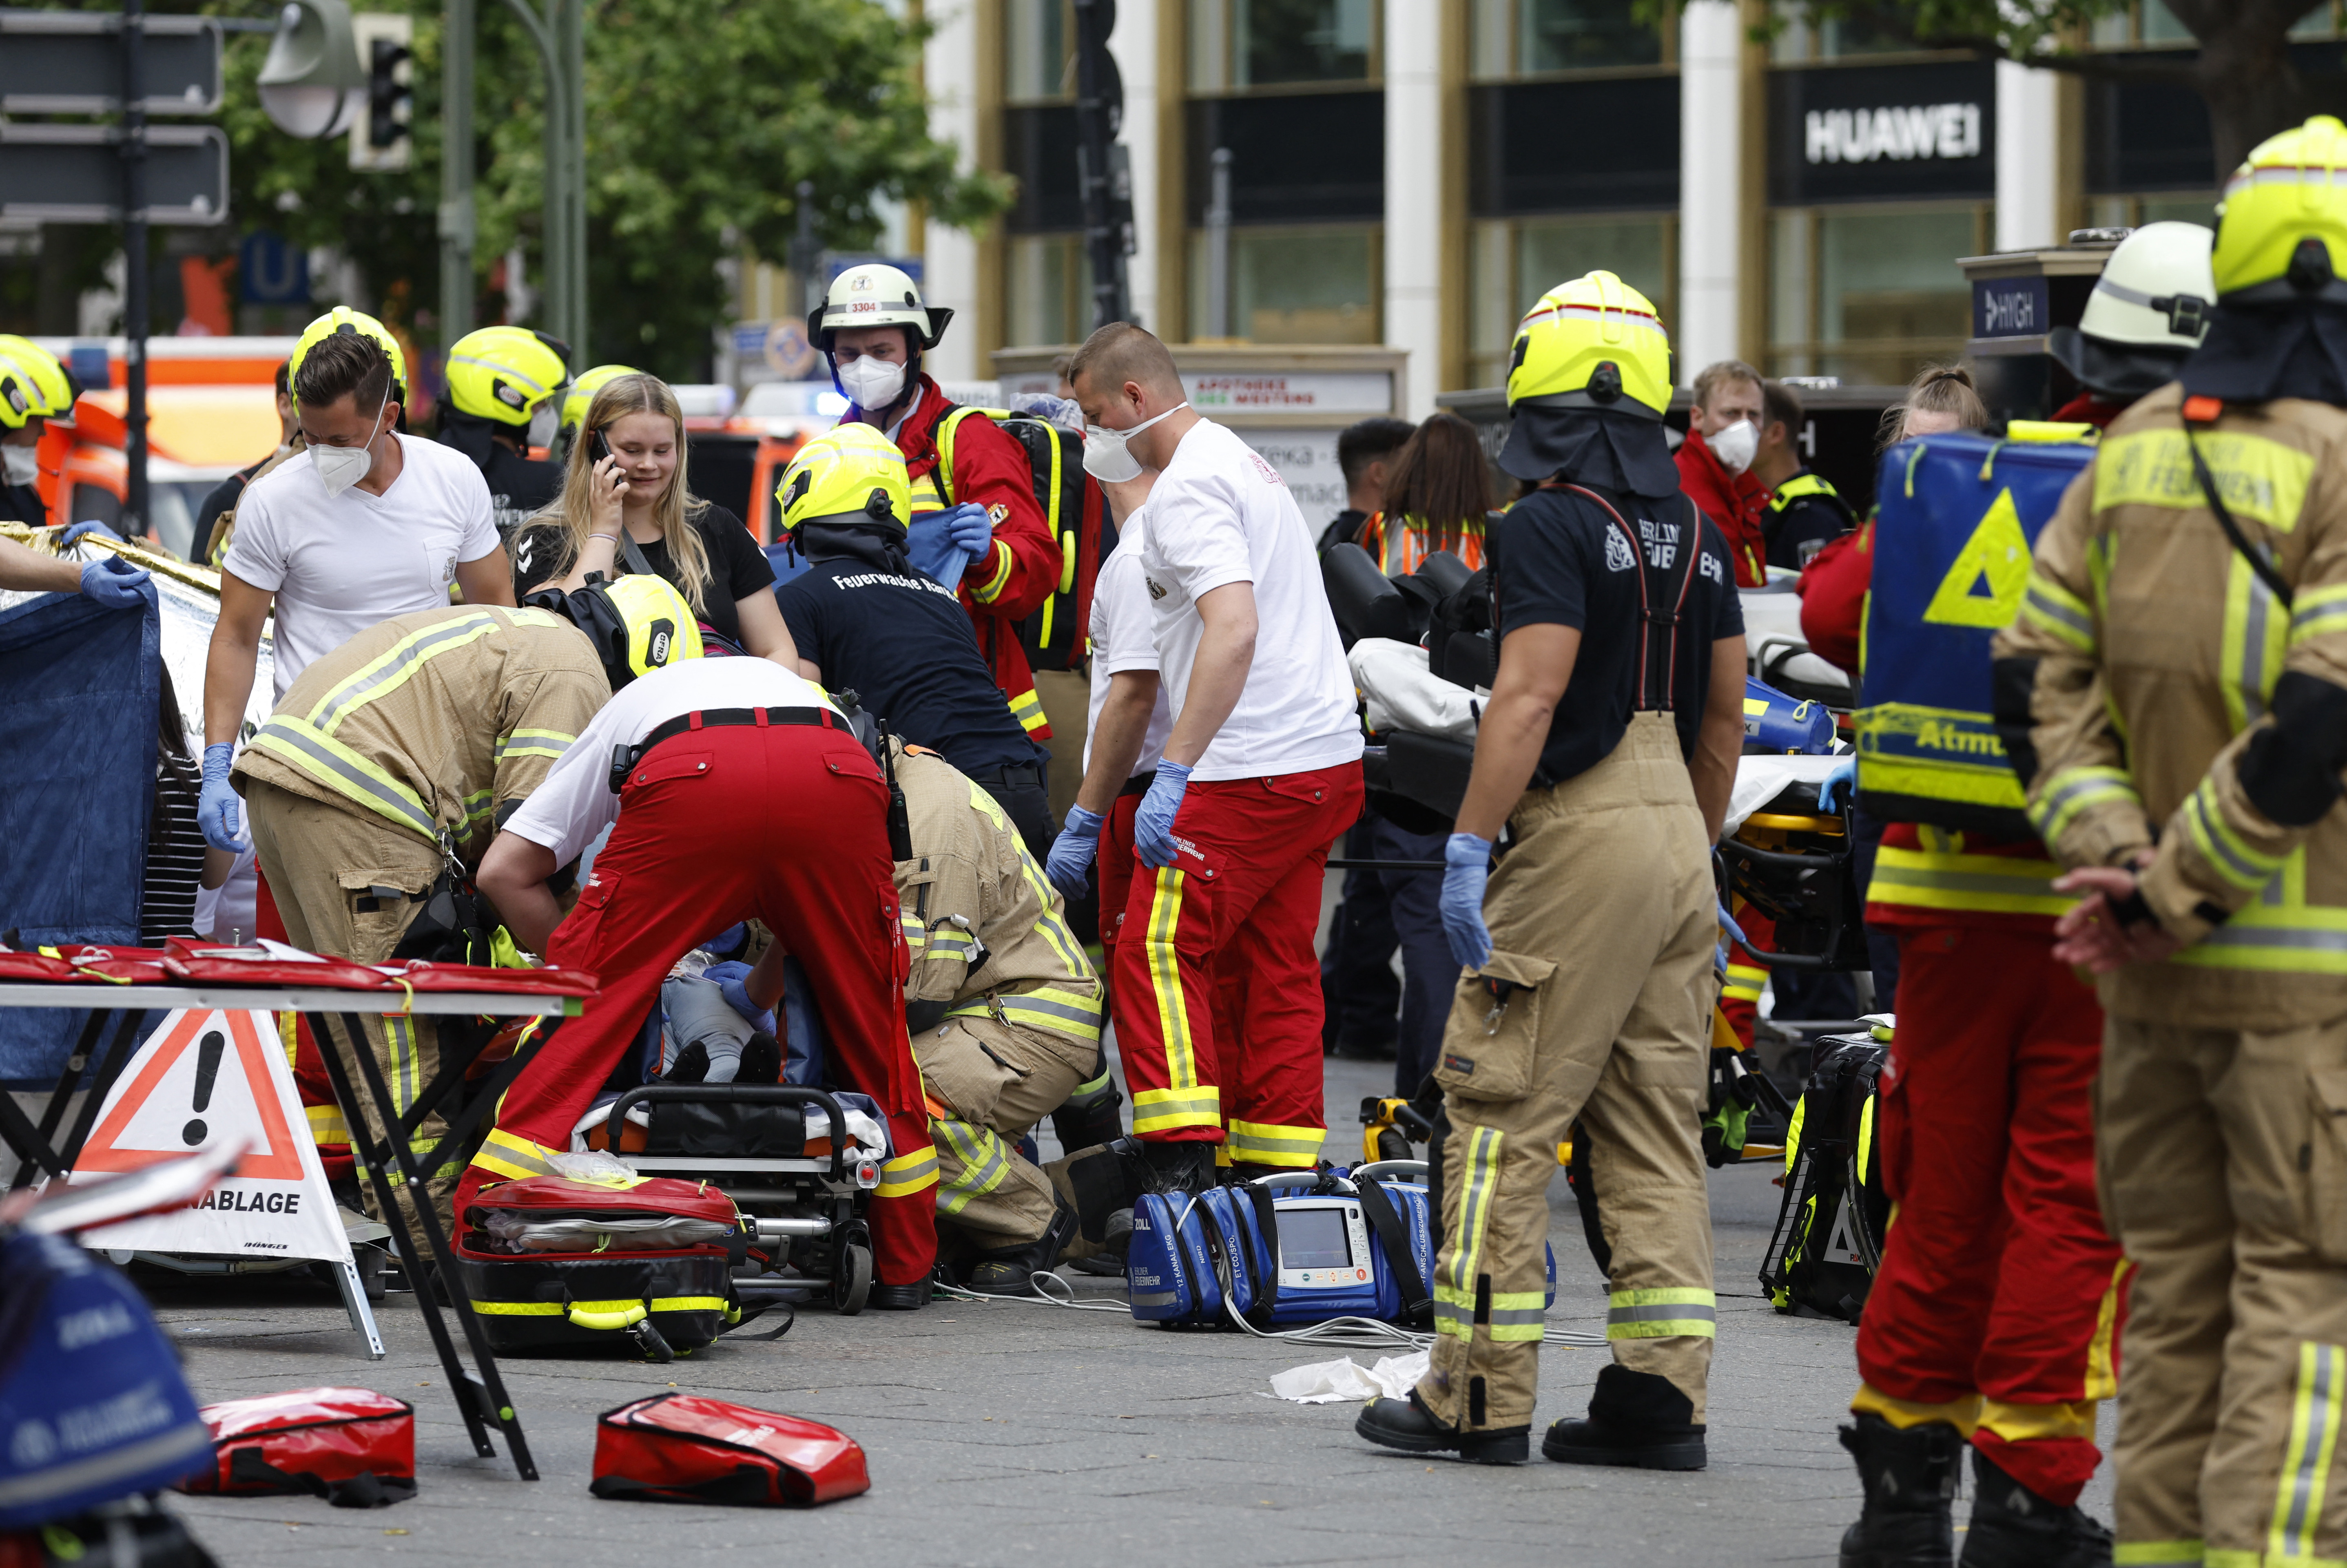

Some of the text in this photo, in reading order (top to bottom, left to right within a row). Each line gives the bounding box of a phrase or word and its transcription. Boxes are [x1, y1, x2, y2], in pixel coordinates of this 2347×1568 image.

[1805, 102, 1981, 163] HUAWEI
[852, 302, 876, 312] 3304
[832, 573, 922, 590] Feuerwache
[656, 635, 666, 659] BFRA
[1135, 1218, 1151, 1230] ZOLL
[1165, 1234, 1184, 1287] 12 KANAL EKG
[1196, 1245, 1205, 1263] NIBD
[1134, 1267, 1148, 1275] BERLINER
[1235, 1269, 1242, 1278] ET
[1135, 1275, 1160, 1286] FEUERWEHR
